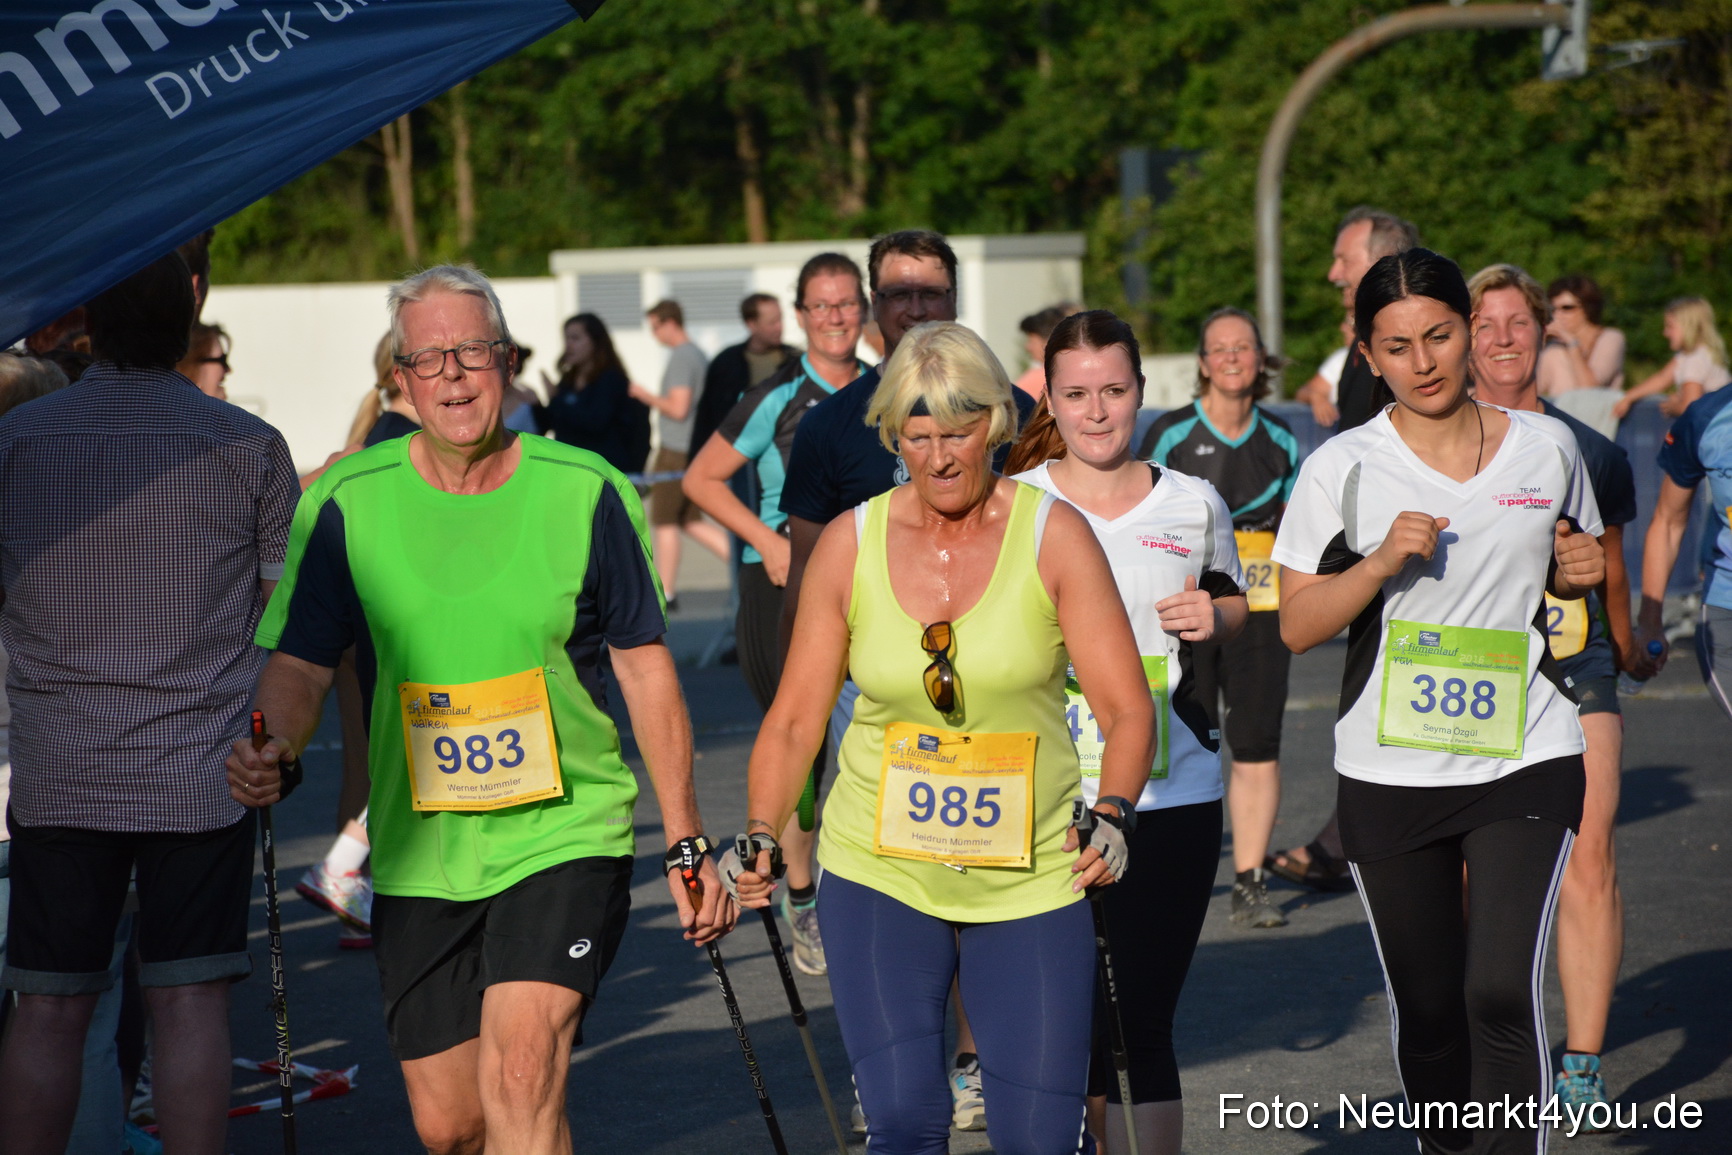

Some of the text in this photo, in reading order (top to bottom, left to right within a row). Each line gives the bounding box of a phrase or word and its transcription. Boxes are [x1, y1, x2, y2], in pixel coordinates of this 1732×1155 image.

[145, 8, 309, 119] Druck
[1507, 496, 1553, 507] partner
[1162, 532, 1183, 542] TEAM
[1150, 541, 1192, 554] partner
[1408, 642, 1460, 657] firmenlauf
[1459, 653, 1485, 664] 2016
[1410, 673, 1496, 720] 388
[422, 704, 472, 716] firmenlauf
[411, 718, 449, 730] walken
[1423, 723, 1479, 738] Seyma Özgül
[433, 728, 525, 775] 983
[906, 746, 958, 764] firmenlauf
[891, 759, 930, 775] walken
[447, 777, 522, 793] Werner Mümmler
[908, 781, 1001, 828] 985
[911, 832, 993, 847] Heidrun Mümmler
[680, 841, 693, 867] LEKI
